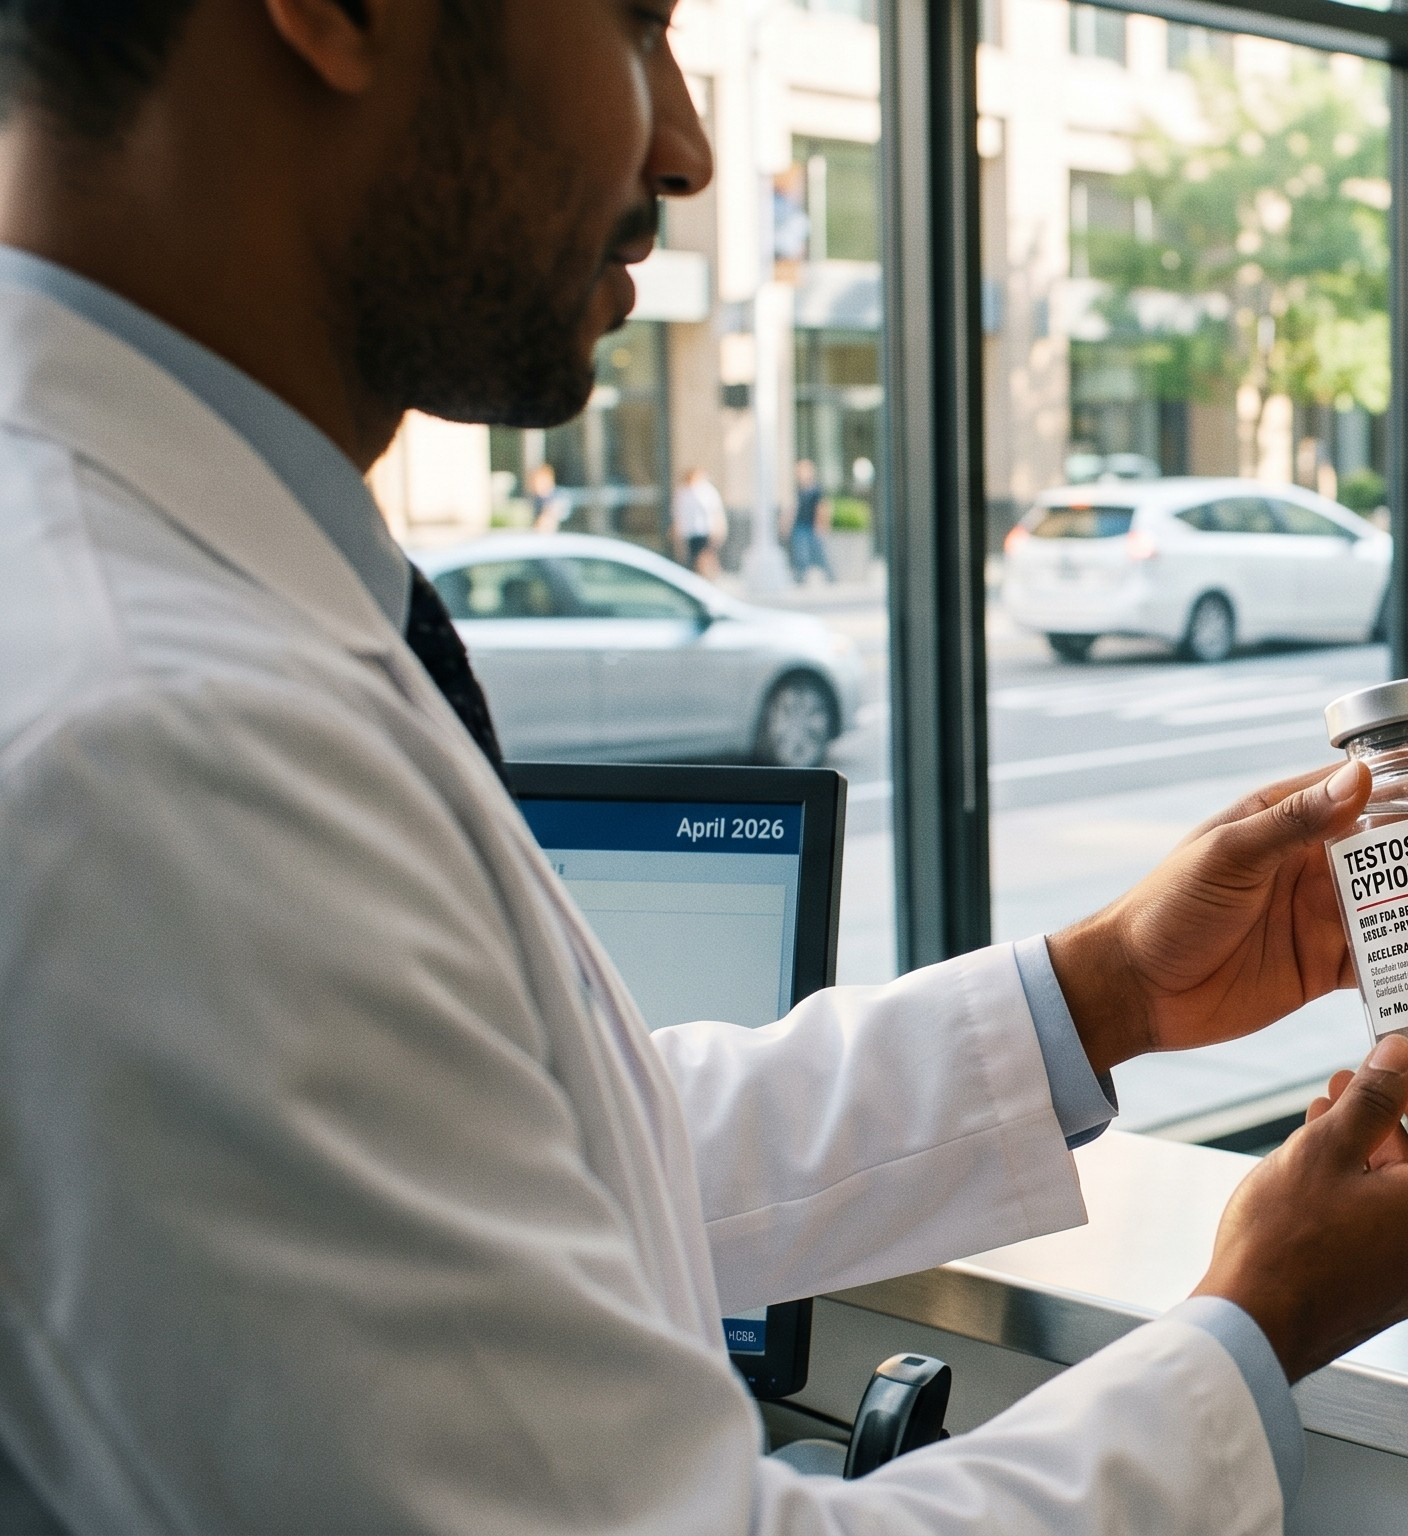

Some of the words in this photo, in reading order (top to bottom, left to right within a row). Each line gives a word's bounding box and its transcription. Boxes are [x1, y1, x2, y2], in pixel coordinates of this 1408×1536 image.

[676, 817, 725, 842] April
[731, 819, 785, 839] 2026
[1379, 909, 1397, 922] FDA
